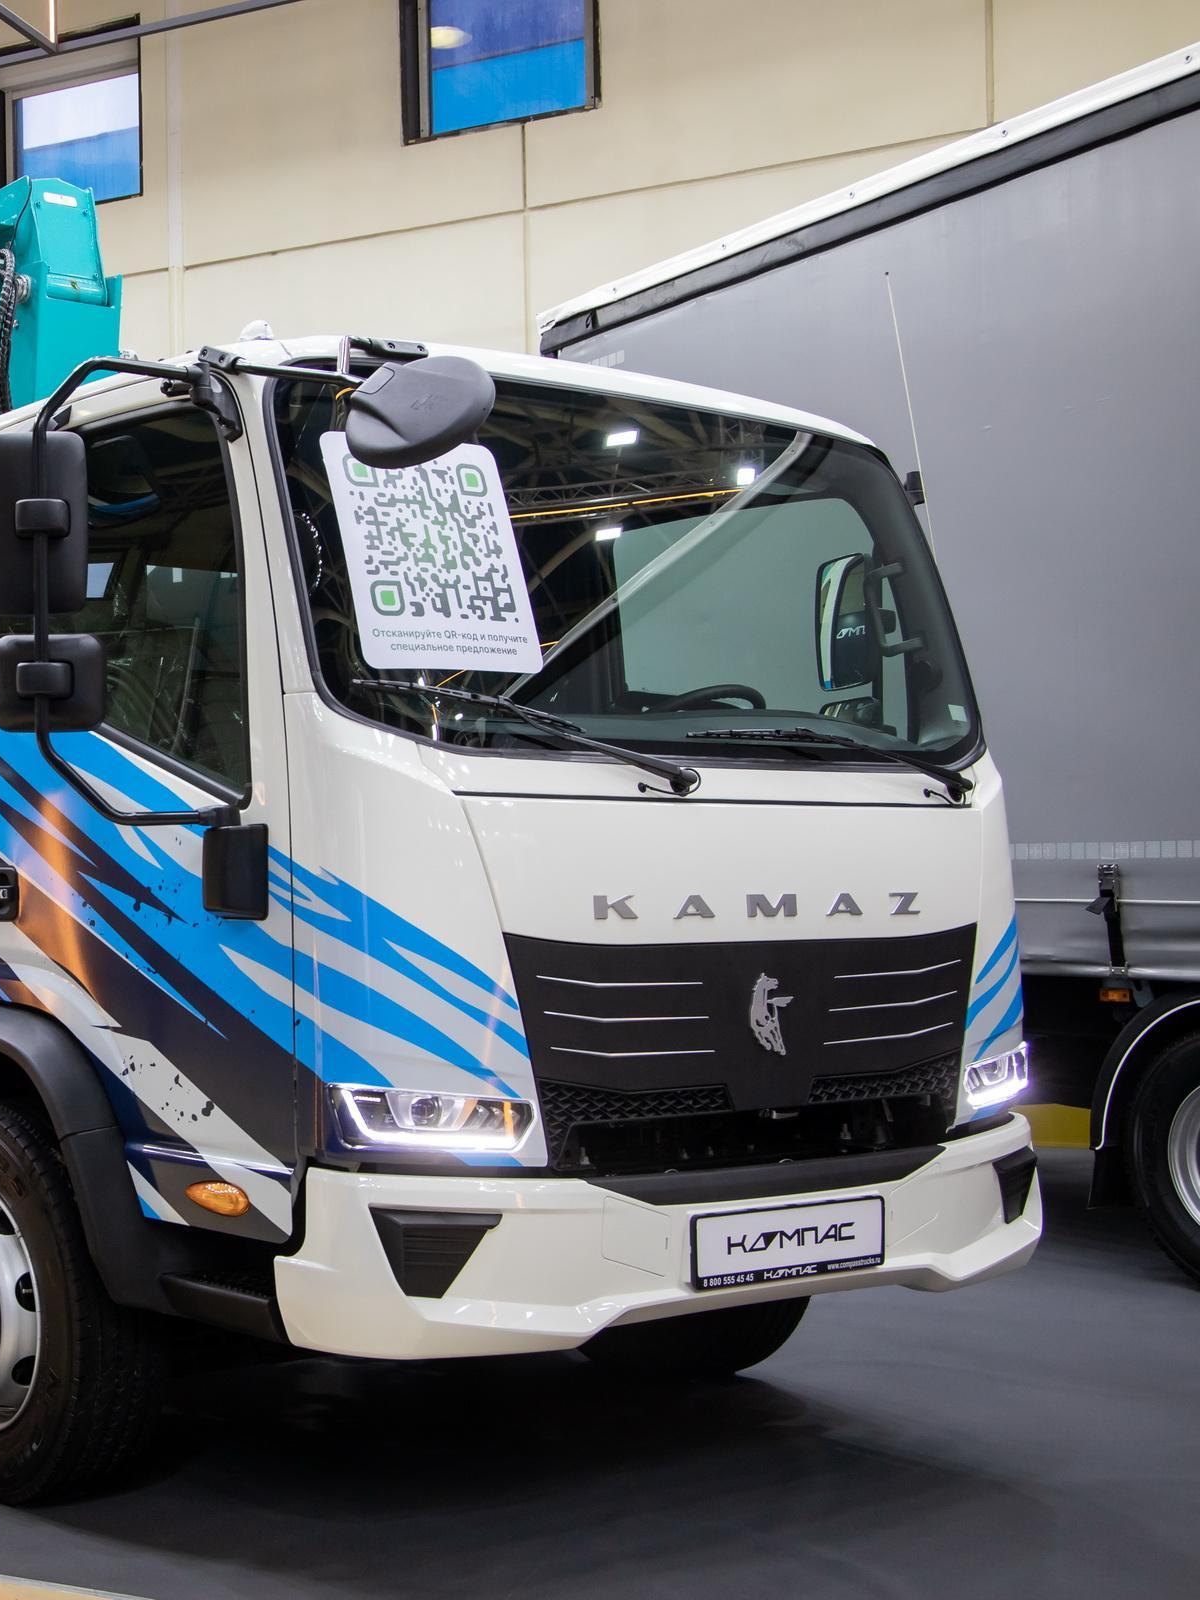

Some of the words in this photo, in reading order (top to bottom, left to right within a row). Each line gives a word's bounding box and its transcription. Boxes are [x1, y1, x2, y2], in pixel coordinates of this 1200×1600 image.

[372, 628, 442, 640] Отсканируйте
[444, 630, 479, 641] QR-код
[480, 633, 486, 641] и
[487, 634, 528, 644] получите
[390, 642, 454, 652] специальное
[456, 645, 518, 656] предложение
[592, 892, 921, 920] KAMAZ
[726, 1222, 856, 1255] КОМПАС
[703, 1279, 708, 1288] 8
[709, 1277, 722, 1287] 800
[723, 1276, 735, 1285] 555
[736, 1275, 745, 1283] 45
[746, 1273, 754, 1282] 45
[827, 1257, 881, 1271] www.compasstrucks.ru
